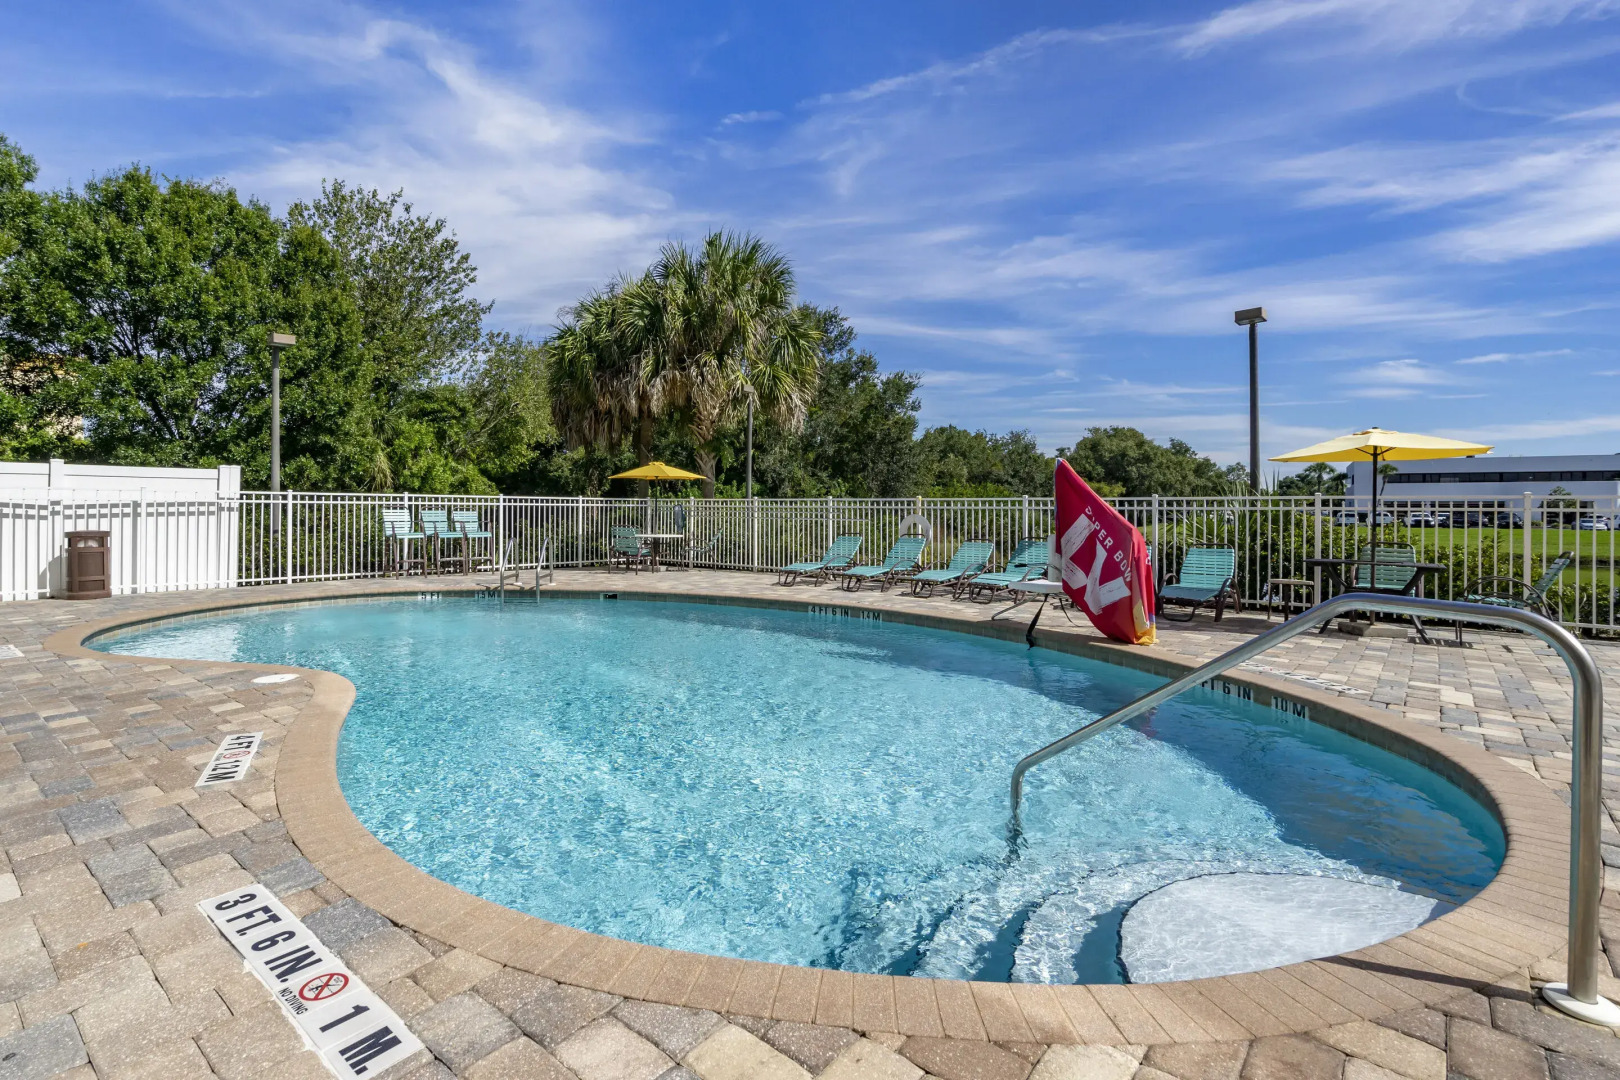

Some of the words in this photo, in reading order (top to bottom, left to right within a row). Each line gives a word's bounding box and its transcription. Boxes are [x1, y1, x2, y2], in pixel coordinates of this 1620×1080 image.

[1085, 506, 1113, 549] SPER
[1114, 550, 1131, 582] BOW
[421, 591, 427, 599] 5
[430, 591, 440, 599] FT
[488, 591, 496, 599] M
[811, 606, 816, 614] 4
[819, 606, 828, 615] FT
[832, 607, 837, 616] 6
[841, 608, 849, 617] IN
[873, 612, 880, 621] M
[1223, 681, 1230, 694] 6
[1238, 685, 1251, 700] IN
[1292, 702, 1305, 719] M
[224, 741, 253, 750] FT
[215, 893, 257, 911] 3
[225, 905, 282, 936] FT.
[251, 930, 296, 951] 6
[264, 944, 322, 983] IN.
[278, 987, 293, 997] NO
[285, 995, 308, 1015] DIVING
[319, 1004, 370, 1033] 1
[338, 1025, 402, 1076] M.
